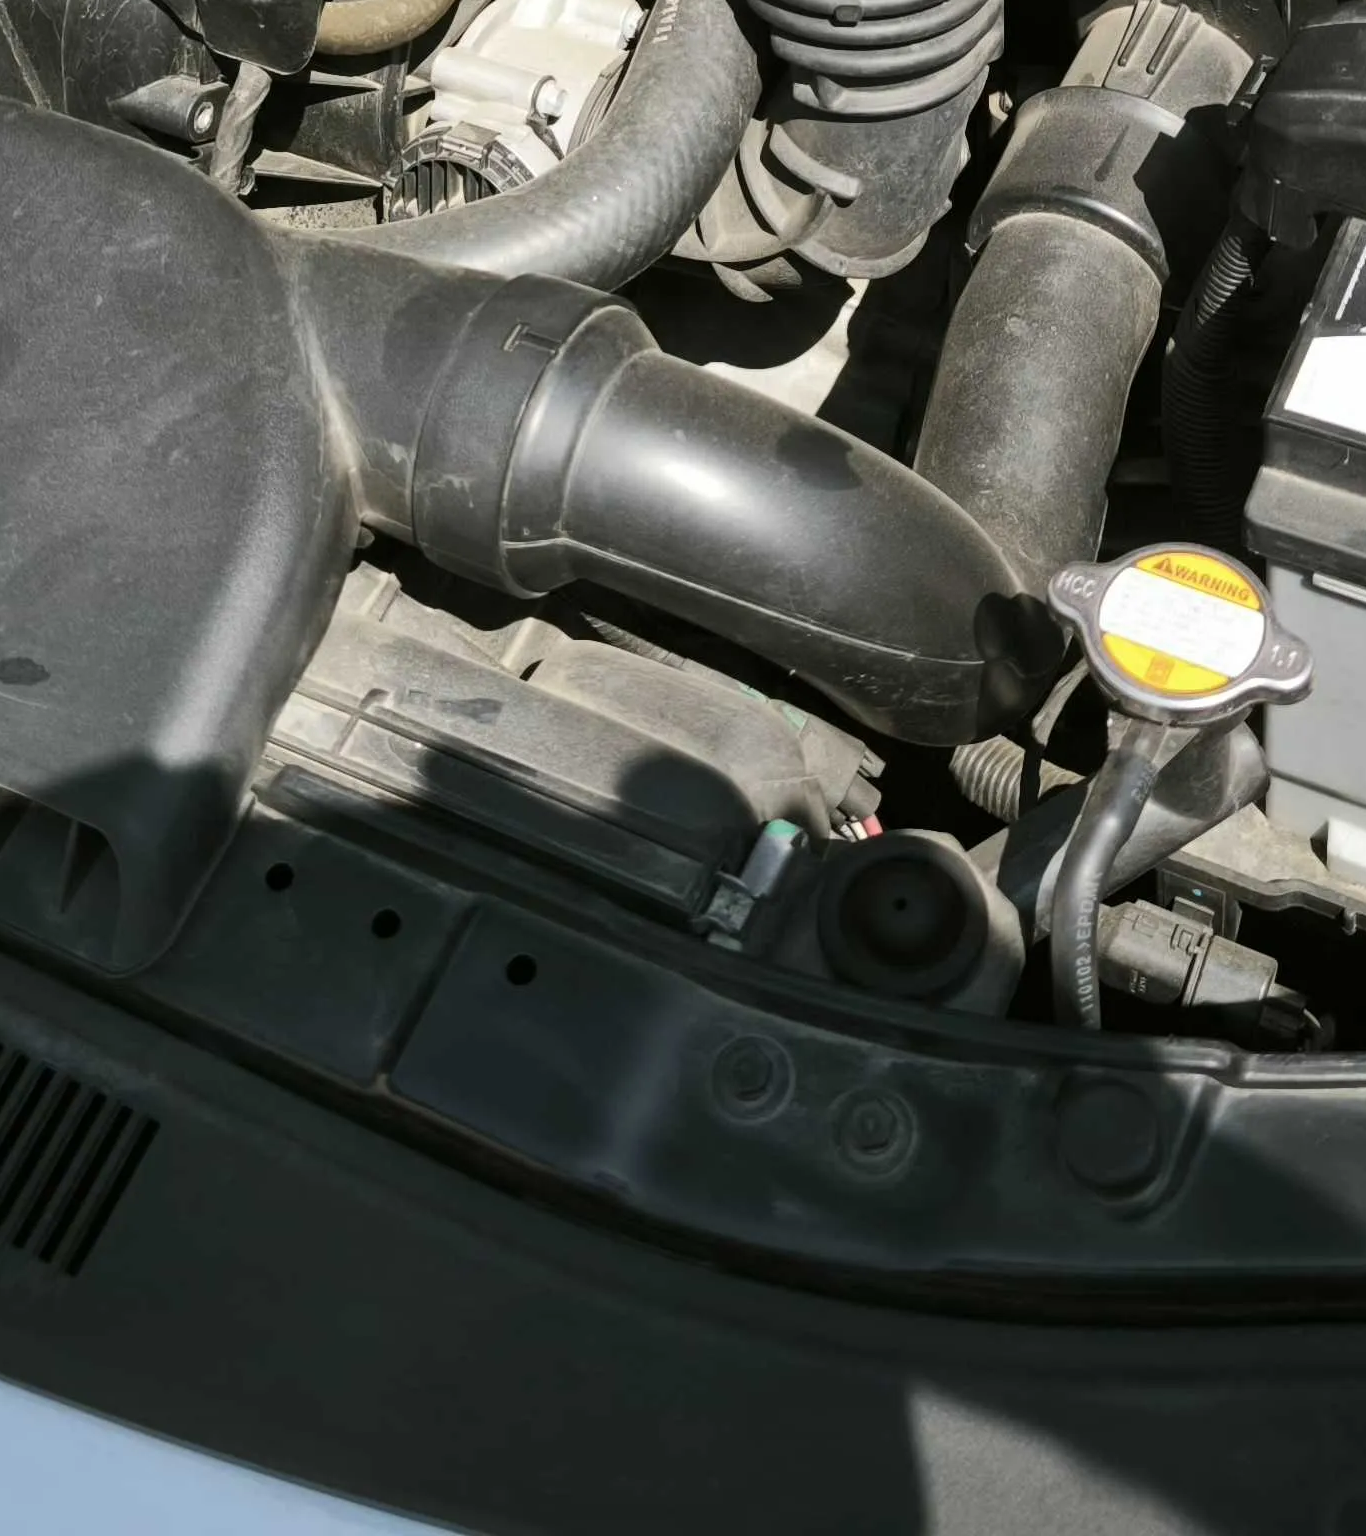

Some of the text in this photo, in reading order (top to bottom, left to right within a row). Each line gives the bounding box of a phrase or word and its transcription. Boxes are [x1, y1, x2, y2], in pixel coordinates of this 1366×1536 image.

[1056, 570, 1097, 599] HCC
[1174, 564, 1251, 602] WARNING
[1270, 643, 1299, 669] 1.1
